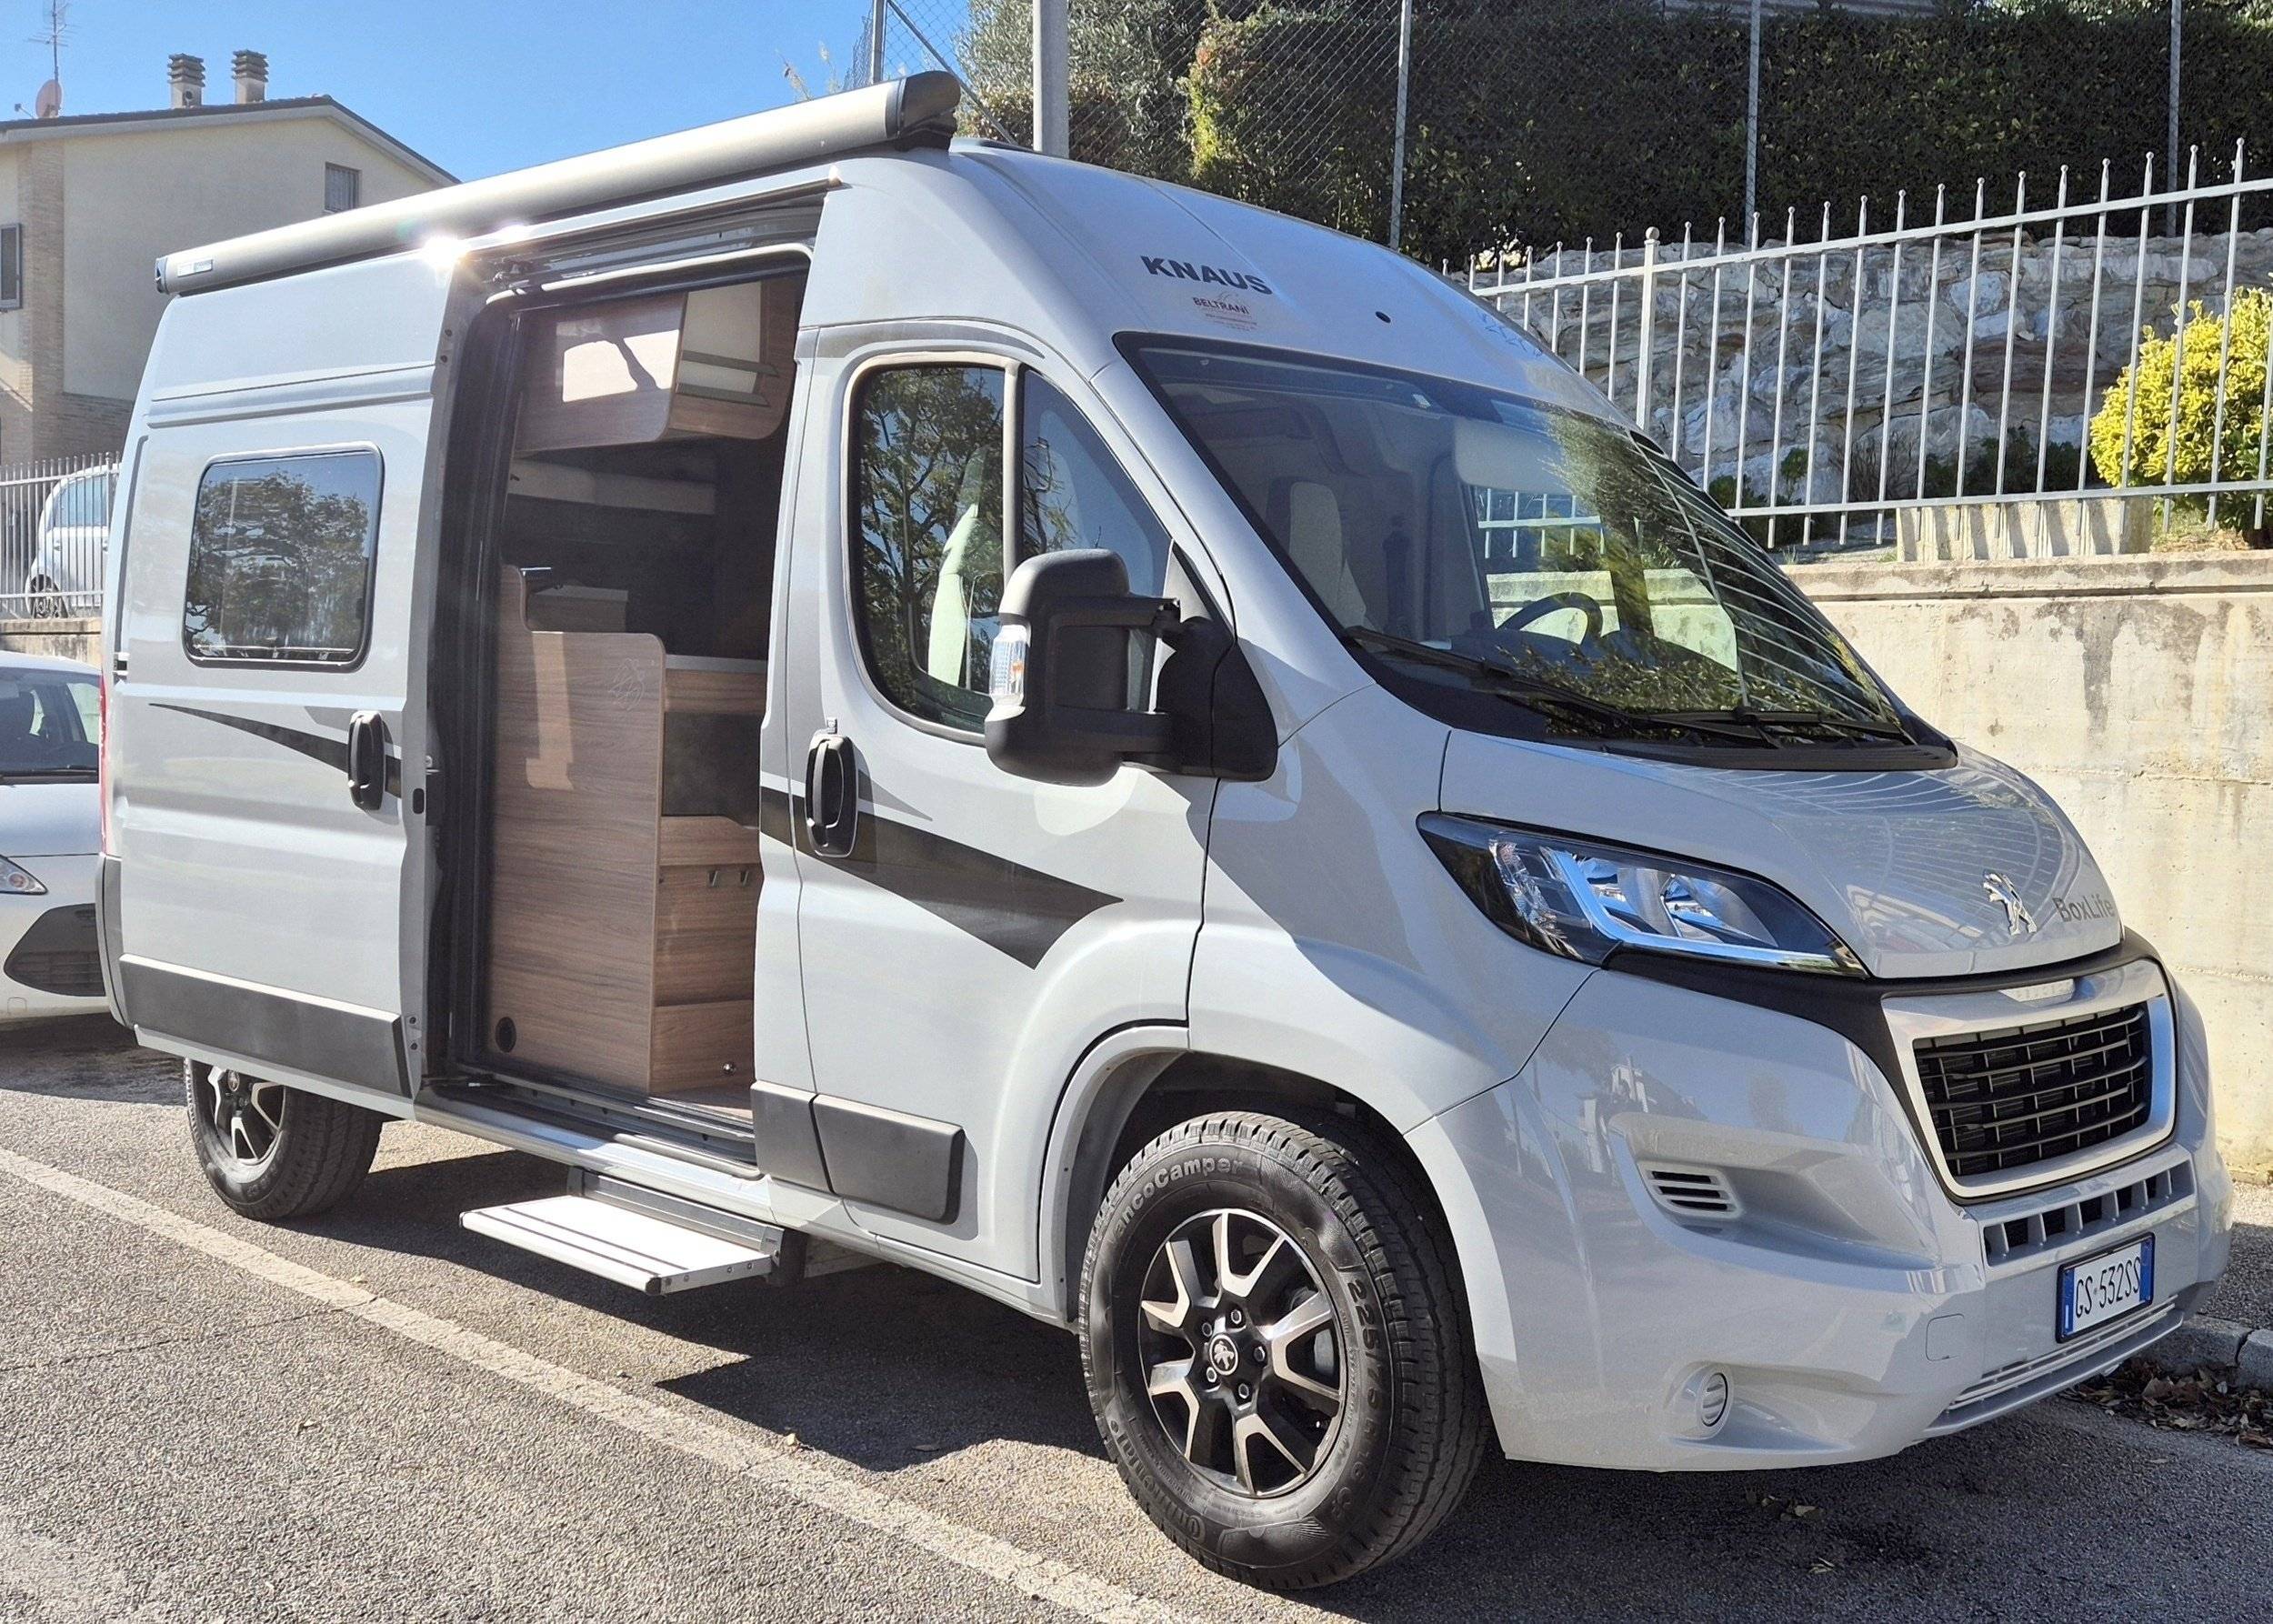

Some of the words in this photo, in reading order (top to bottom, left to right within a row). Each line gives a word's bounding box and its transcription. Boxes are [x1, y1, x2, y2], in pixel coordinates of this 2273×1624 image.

[1140, 256, 1273, 295] KNAUS
[1193, 296, 1249, 314] BELTRANI
[2053, 894, 2117, 922] BoxLife
[1107, 1157, 1243, 1243] ancoCamper
